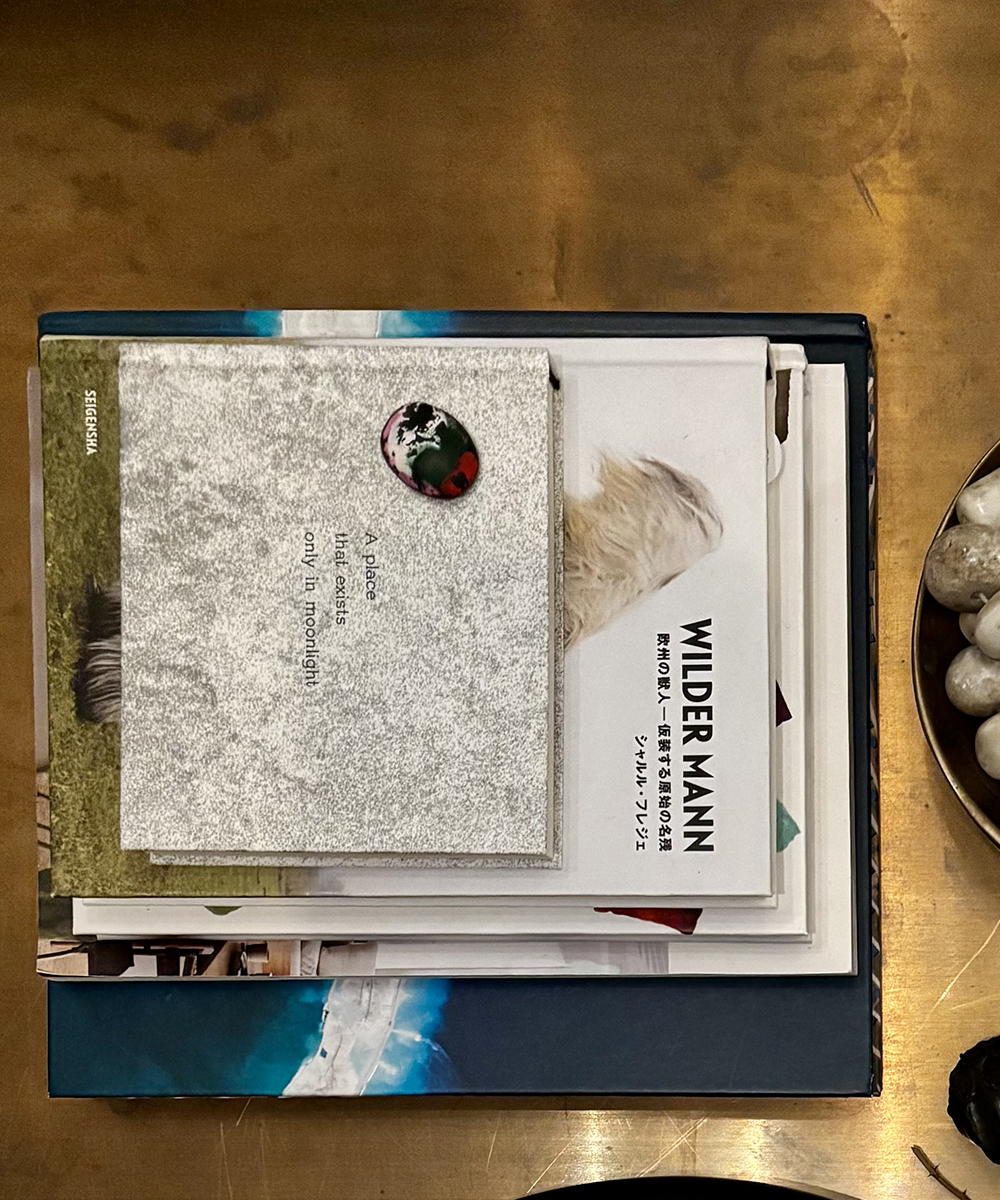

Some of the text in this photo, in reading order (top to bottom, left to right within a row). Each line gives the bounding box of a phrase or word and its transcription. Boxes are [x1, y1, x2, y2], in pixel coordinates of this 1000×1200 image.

[84, 389, 98, 456] SEIGENSHA
[301, 532, 320, 688] only in moonlight
[335, 532, 349, 626] that exists
[362, 532, 380, 601] A place
[679, 618, 714, 852] WILDER MANN
